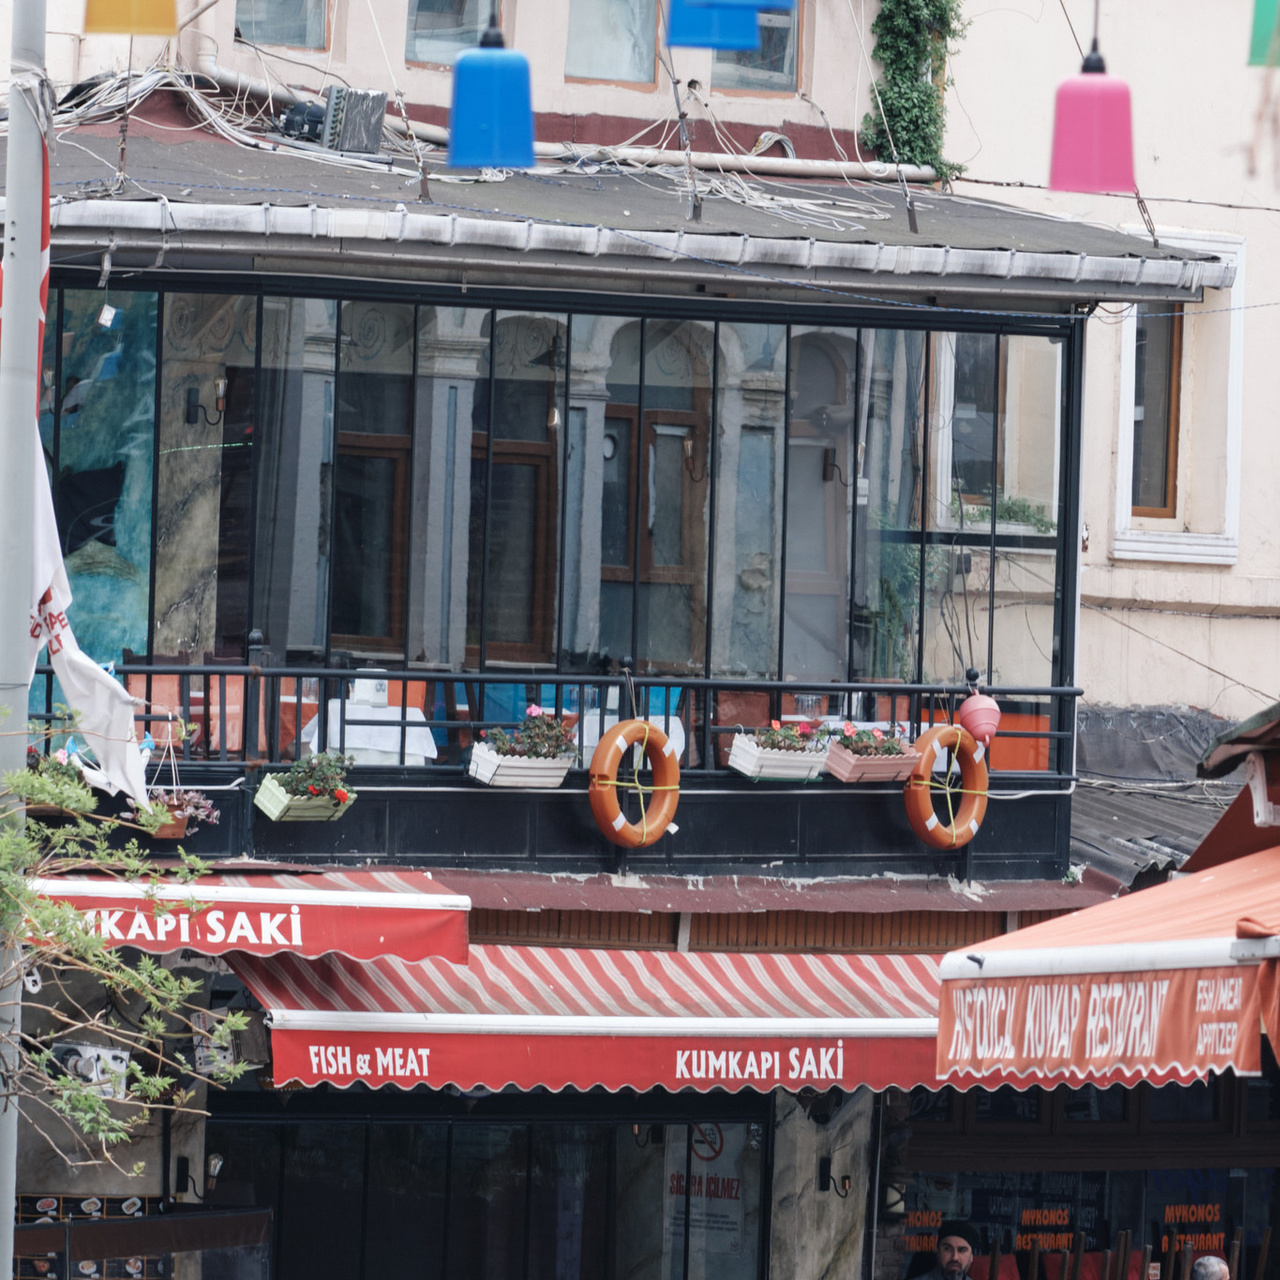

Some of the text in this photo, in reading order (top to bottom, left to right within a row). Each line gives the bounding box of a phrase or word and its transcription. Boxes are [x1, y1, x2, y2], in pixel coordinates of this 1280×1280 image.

[206, 904, 302, 946] SAKİ
[1022, 982, 1083, 1059] KUMKAP
[308, 1045, 430, 1077] FISH & MEAT
[675, 1038, 844, 1080] KUMKAPI SAKİ
[669, 1170, 703, 1197] SİGRA
[904, 1210, 942, 1227] KONOS
[1021, 1209, 1069, 1227] MYKONOS
[1164, 1203, 1220, 1224] MYKONOS
[1162, 1232, 1225, 1253] RSTAURANT
